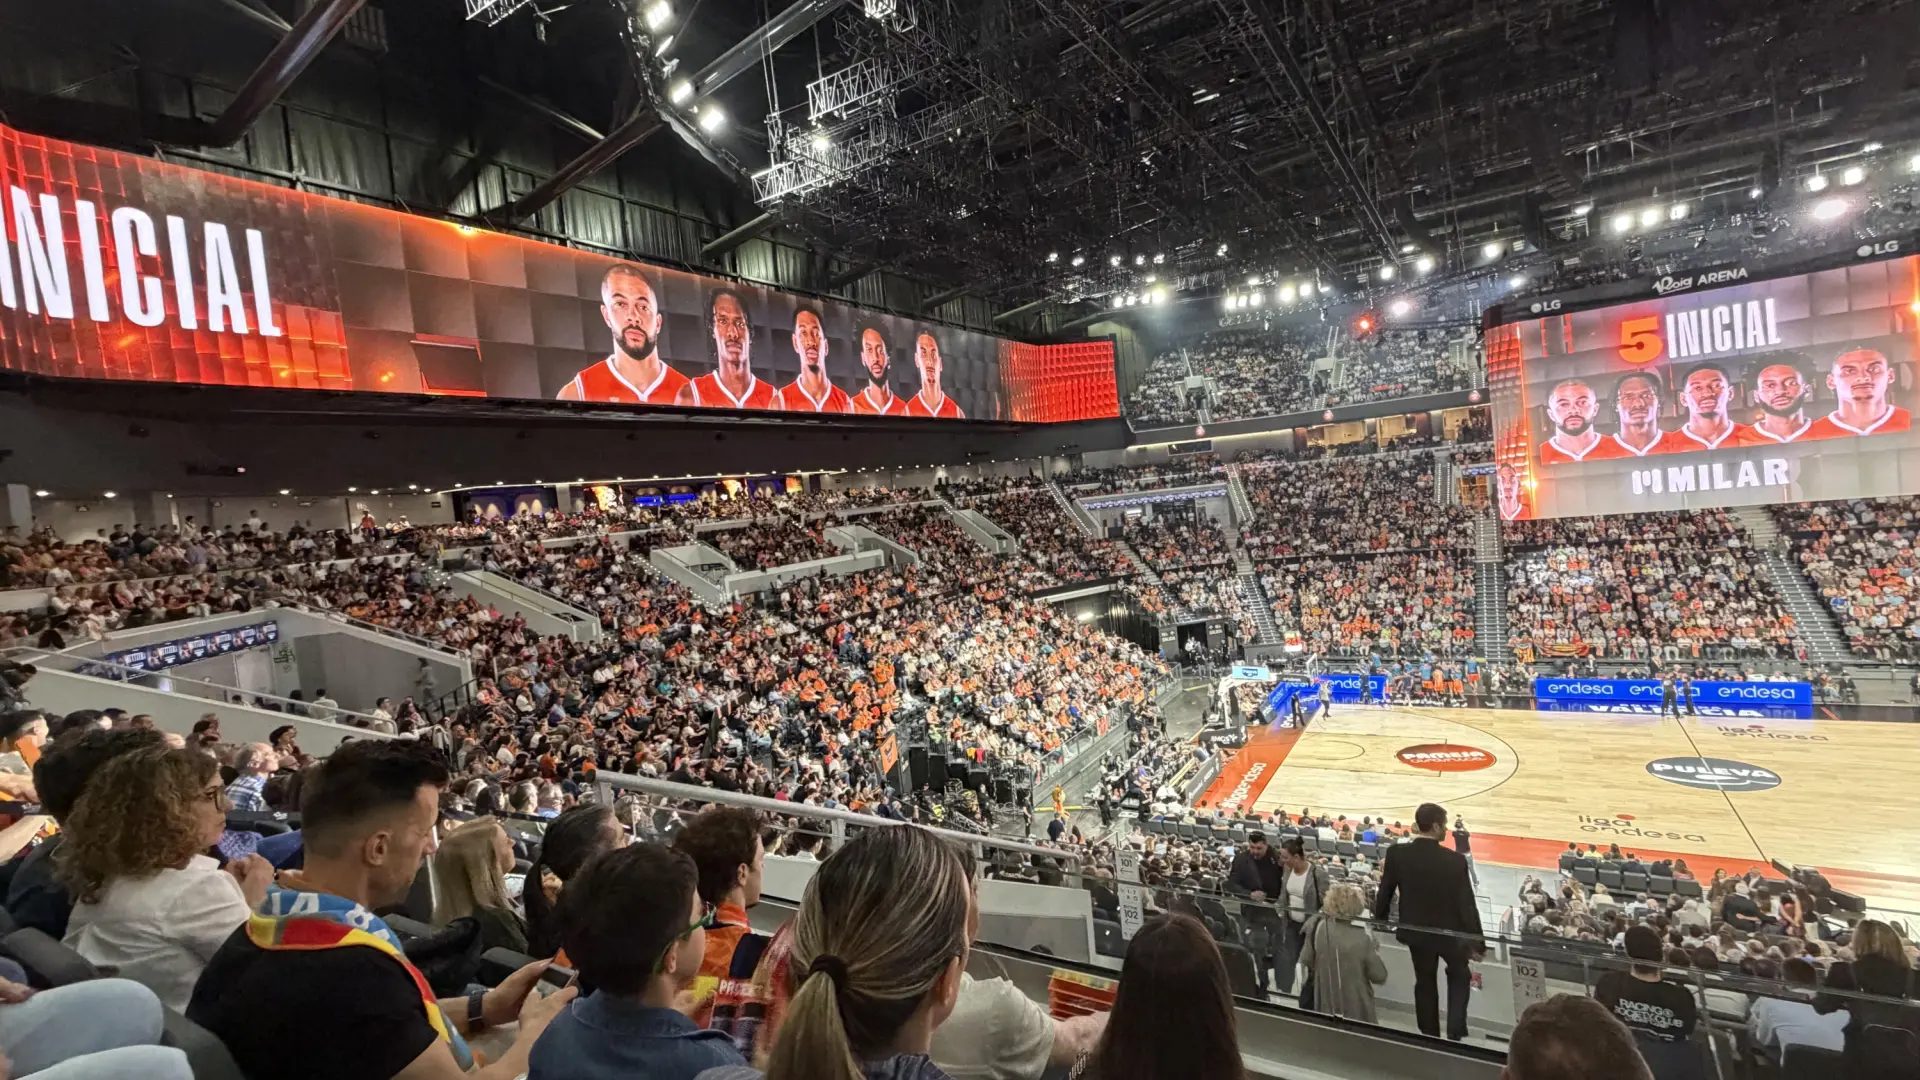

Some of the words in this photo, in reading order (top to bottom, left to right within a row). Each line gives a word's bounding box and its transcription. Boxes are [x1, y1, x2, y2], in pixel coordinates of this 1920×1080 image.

[1874, 240, 1899, 254] LG
[1697, 267, 1748, 286] ARENA
[1543, 300, 1561, 311] LG
[1619, 315, 1663, 363] 5
[1665, 298, 1781, 359] INICIAL
[1668, 458, 1789, 493] MILAR
[1327, 677, 1378, 689] endea
[1548, 682, 1613, 694] endesa
[1718, 685, 1796, 699] endesa
[1652, 763, 1777, 778] PULEVA
[1579, 815, 1632, 827] liga
[1580, 825, 1706, 842] endesa
[1121, 859, 1133, 868] 101
[1124, 909, 1138, 919] 102
[1517, 965, 1538, 978] 102
